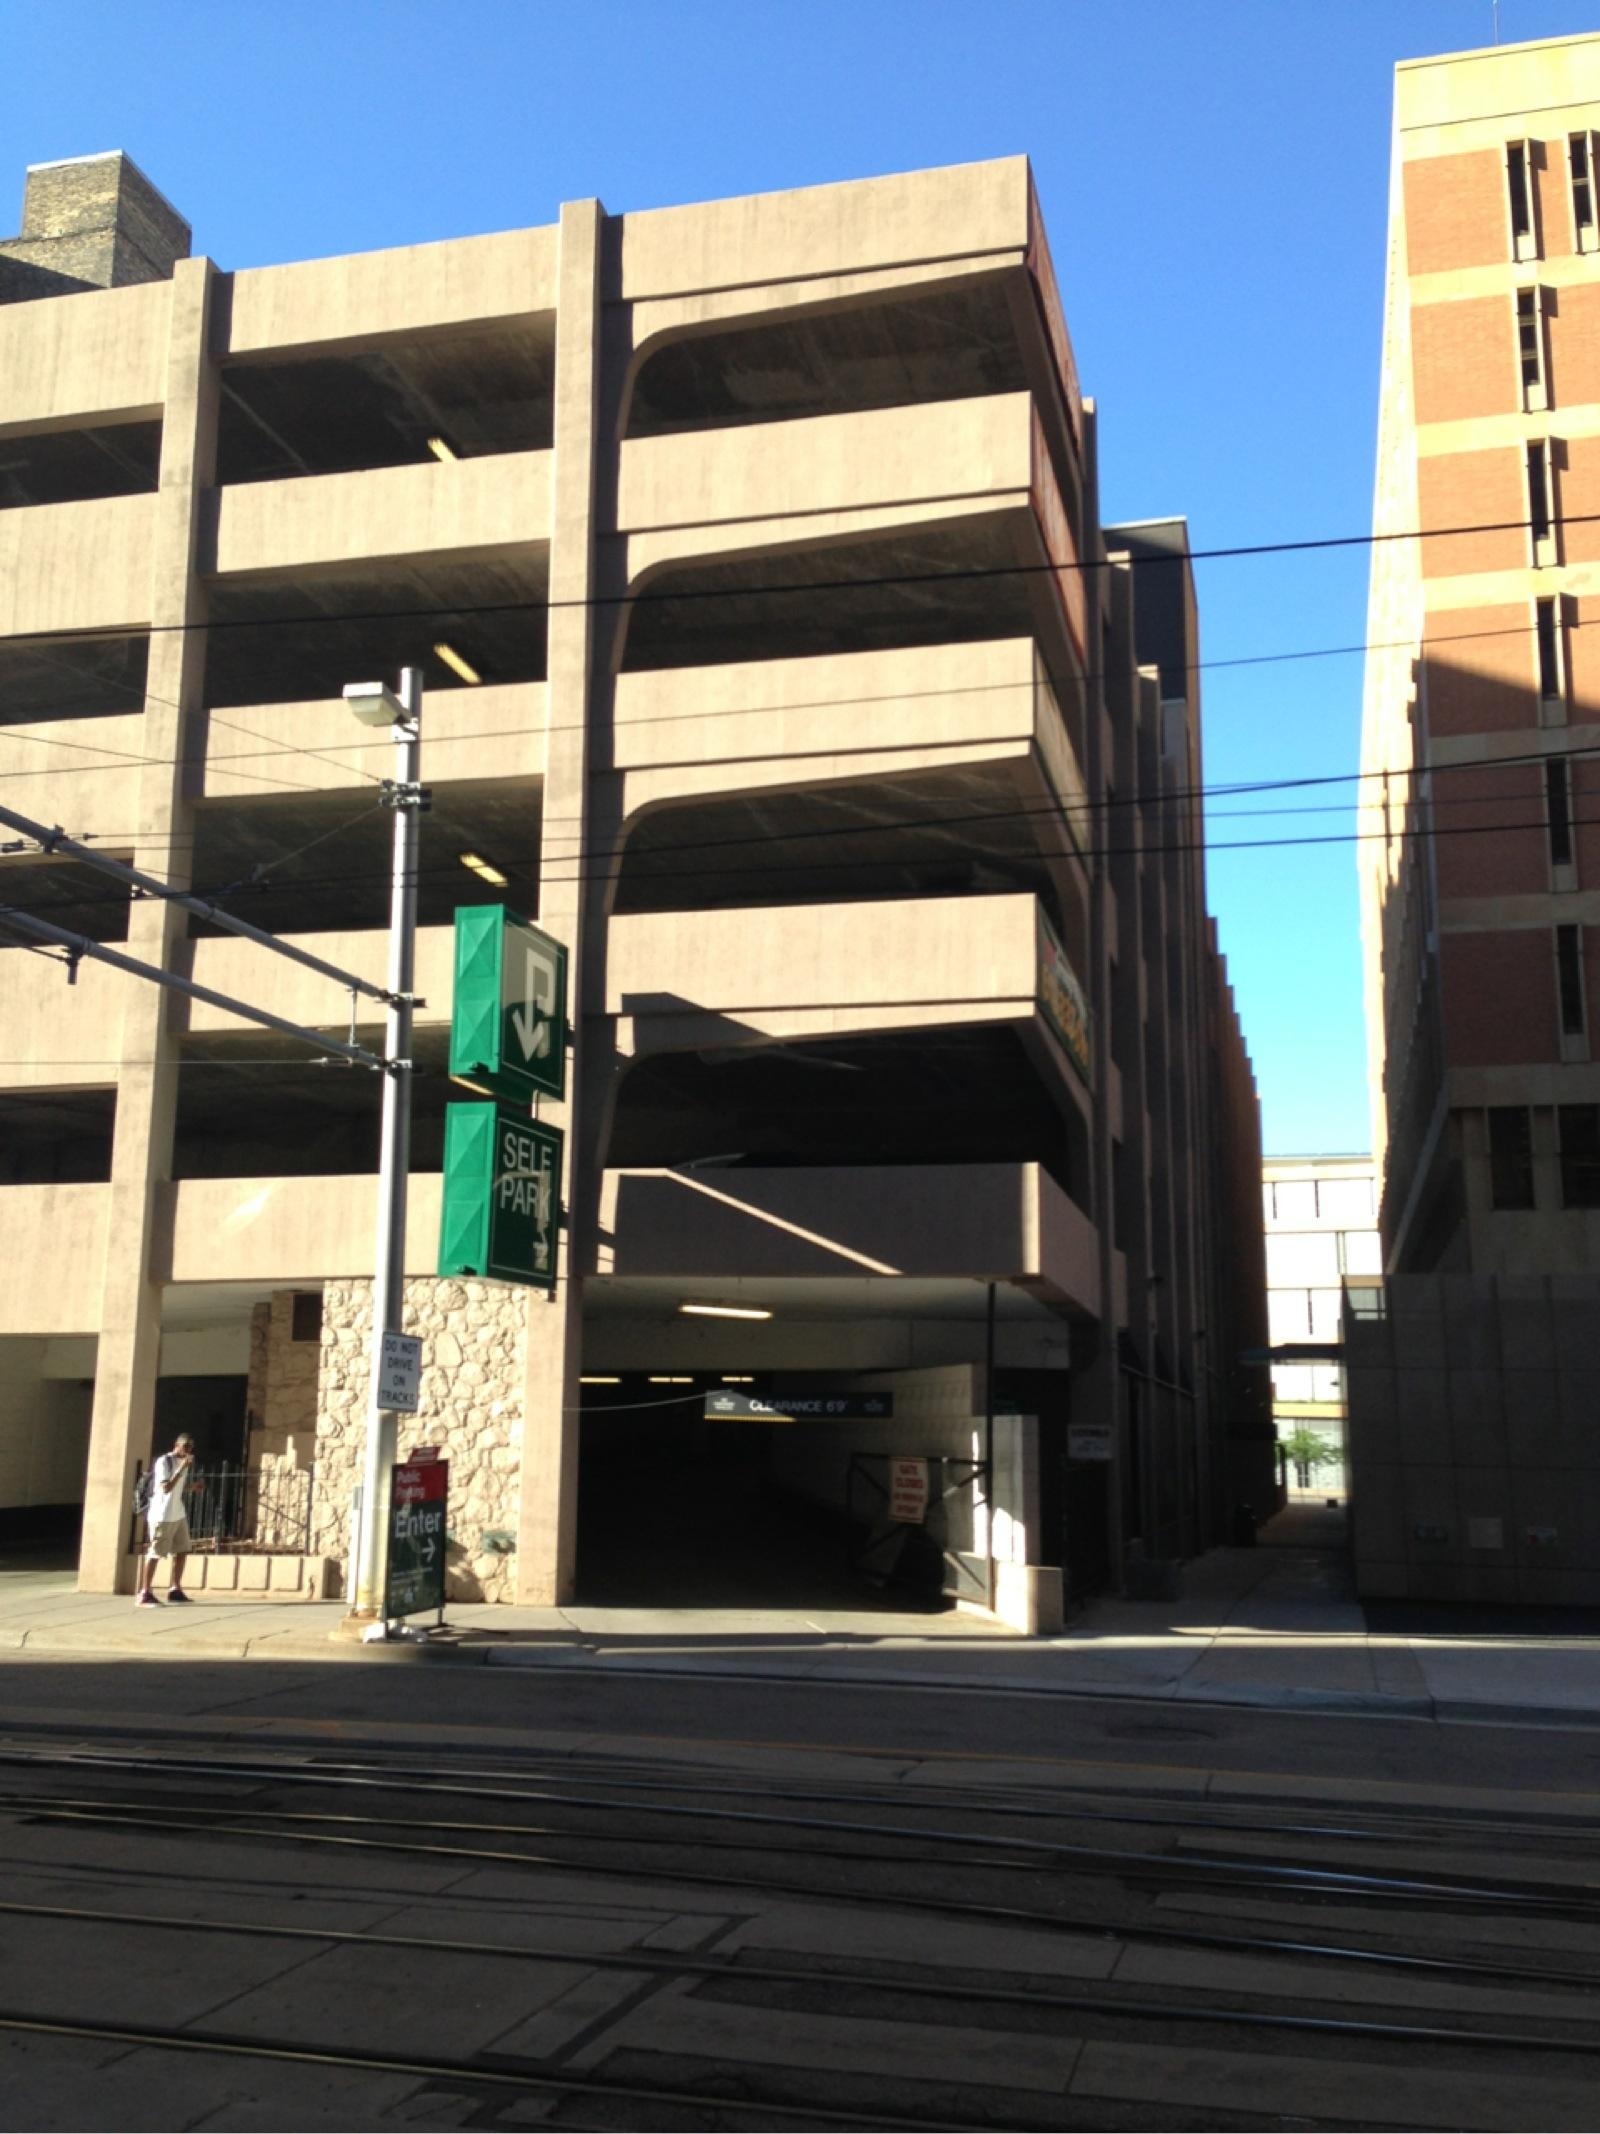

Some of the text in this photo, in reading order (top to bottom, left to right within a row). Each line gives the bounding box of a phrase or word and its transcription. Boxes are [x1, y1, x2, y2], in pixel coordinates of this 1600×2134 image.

[503, 1132, 552, 1173] SELF
[500, 1174, 551, 1222] PARK
[387, 1356, 413, 1372] DRIVE
[392, 1374, 405, 1387] ON
[381, 1389, 415, 1405] TRACKS
[749, 1399, 822, 1412] CLEARANCE
[394, 1508, 442, 1539] Enter
